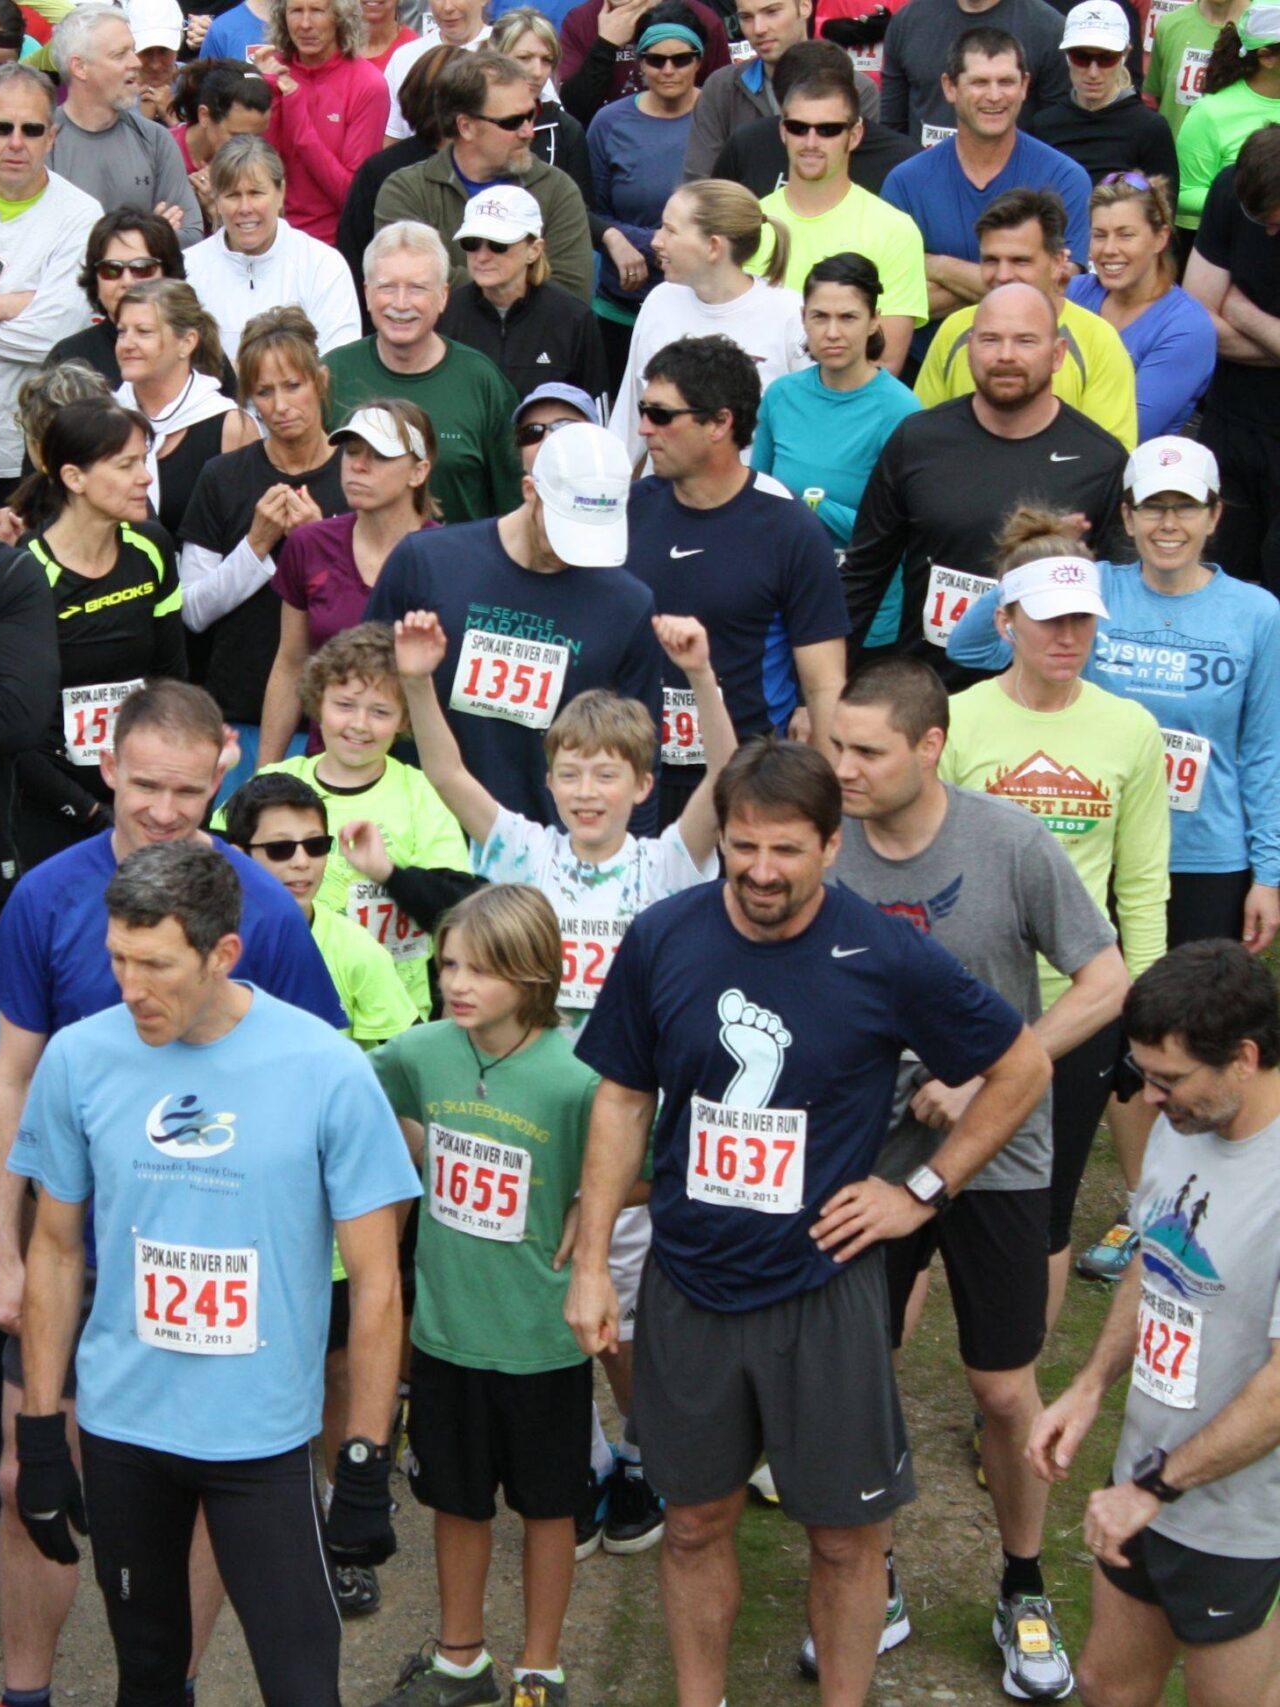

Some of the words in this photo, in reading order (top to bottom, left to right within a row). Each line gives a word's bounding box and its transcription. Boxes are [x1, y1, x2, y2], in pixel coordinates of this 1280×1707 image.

[83, 581, 154, 613] BROOKS
[492, 606, 555, 629] SEATTLE
[465, 615, 582, 656] MARATHON
[471, 635, 512, 657] SPOKANE
[514, 641, 541, 662] RIVER
[543, 647, 562, 665] RUN
[464, 656, 554, 711] 1351
[1156, 667, 1185, 683] Fun
[1184, 654, 1235, 691] 30
[73, 705, 122, 747] 15
[514, 707, 535, 720] 2013
[1184, 737, 1203, 753] RUN
[1037, 786, 1057, 795] 2011
[1060, 800, 1113, 818] LAKE
[1047, 821, 1086, 832] THON
[581, 920, 609, 937] RIVER
[561, 940, 621, 985] 52
[443, 1100, 551, 1144] SKATEBOARDING
[698, 1107, 738, 1130] SPOKANE
[742, 1112, 775, 1132] RIVER
[777, 1115, 798, 1134] RUN
[435, 1130, 472, 1156] SPOKANE
[474, 1142, 500, 1164] RIVER
[502, 1149, 523, 1170] RUN
[695, 1130, 795, 1188] 1637
[434, 1156, 519, 1218] 1655
[704, 1183, 731, 1197] APRIL
[734, 1189, 750, 1201] 21,
[753, 1192, 779, 1204] 2013
[439, 1205, 458, 1220] APRIL
[461, 1213, 475, 1225] 21,
[477, 1217, 501, 1231] 2013
[142, 1245, 187, 1271] SPOKANE
[190, 1253, 222, 1274] RIVER
[225, 1255, 248, 1274] RUN
[144, 1273, 248, 1328] 1245
[1204, 1282, 1226, 1293] Club
[1178, 1306, 1194, 1329] RUN
[154, 1327, 182, 1342] APRIL
[185, 1332, 201, 1345] 21,
[205, 1334, 232, 1345] 2013
